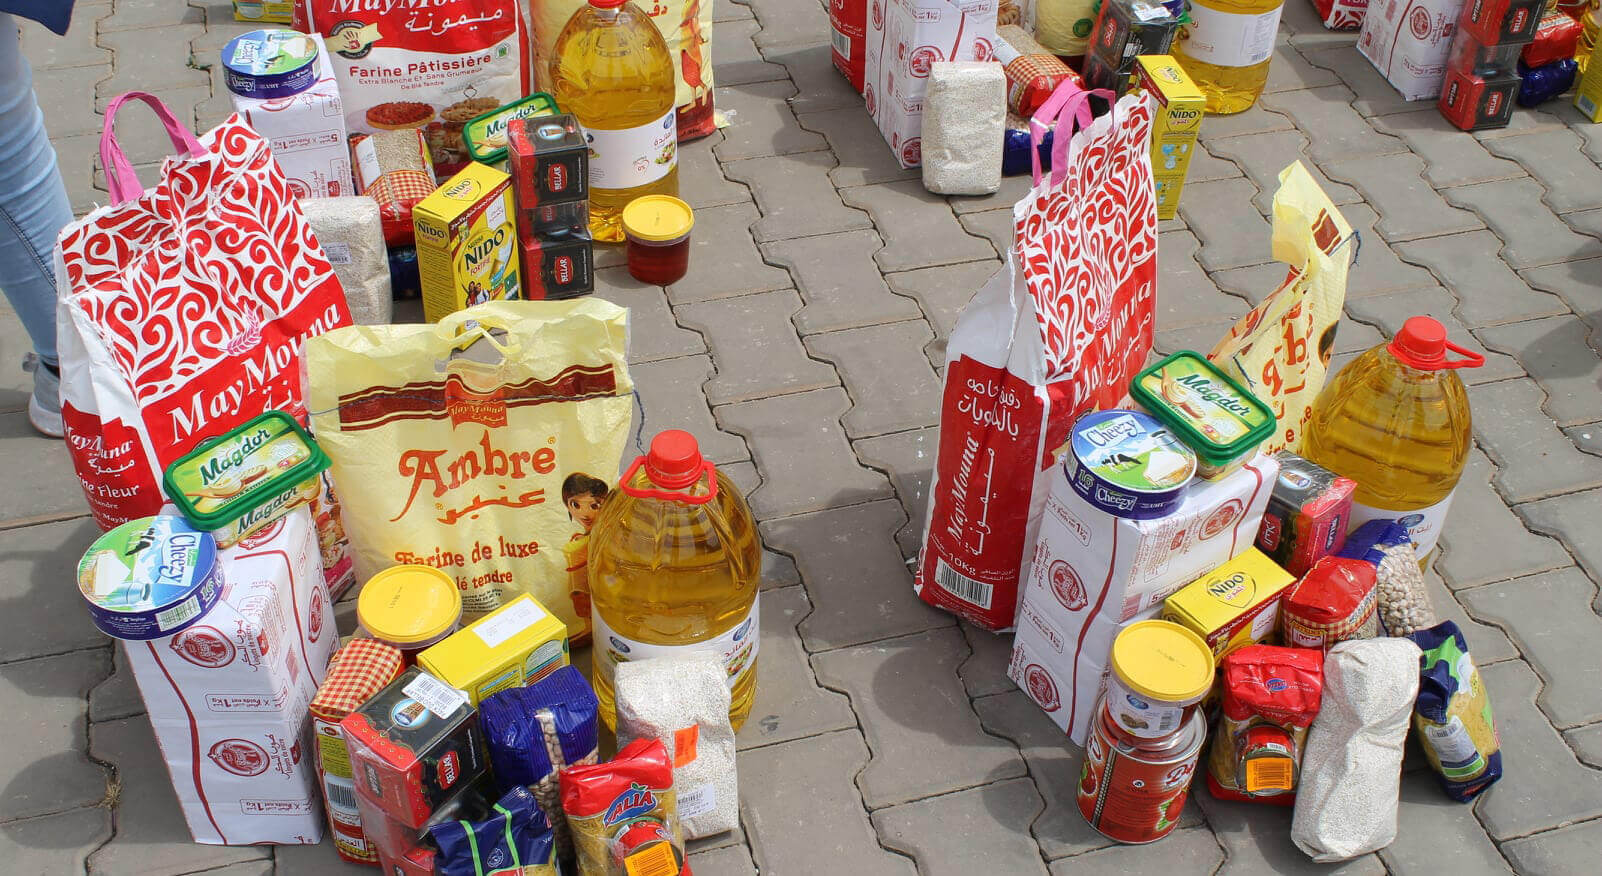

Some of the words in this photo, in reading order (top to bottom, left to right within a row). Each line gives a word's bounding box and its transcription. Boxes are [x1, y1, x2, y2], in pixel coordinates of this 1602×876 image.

[405, 9, 503, 36] ميمونة
[349, 66, 402, 78] Farine
[408, 54, 491, 75] Pâtissière
[486, 104, 536, 138] Mador
[1169, 110, 1197, 119] NIDO
[446, 180, 471, 198] NIDO
[553, 166, 562, 191] BELLAR
[417, 222, 445, 239] NIDO
[464, 229, 504, 271] NIDO
[560, 258, 569, 283] BELLAR
[166, 303, 340, 445] MayMouna
[1176, 373, 1251, 417] Magdor
[1086, 417, 1139, 447] Cheezy
[200, 428, 271, 485] Magdor
[79, 472, 95, 495] ine
[98, 484, 140, 498] Fleur
[389, 430, 556, 522] Ambre
[947, 435, 979, 543] MayMouna
[1079, 470, 1094, 488] 16
[238, 486, 298, 534] Magdor
[436, 485, 545, 525] عنبر
[1097, 488, 1135, 510] Cheezy
[155, 534, 196, 583] Cheezy
[472, 541, 492, 563] de
[498, 535, 539, 558] luxe
[948, 552, 977, 576] 10Kg
[456, 575, 468, 590] lé
[471, 569, 513, 589] tendre
[1210, 574, 1244, 597] NIDO
[442, 754, 456, 784] BELLAR
[604, 790, 653, 828] ALIA
